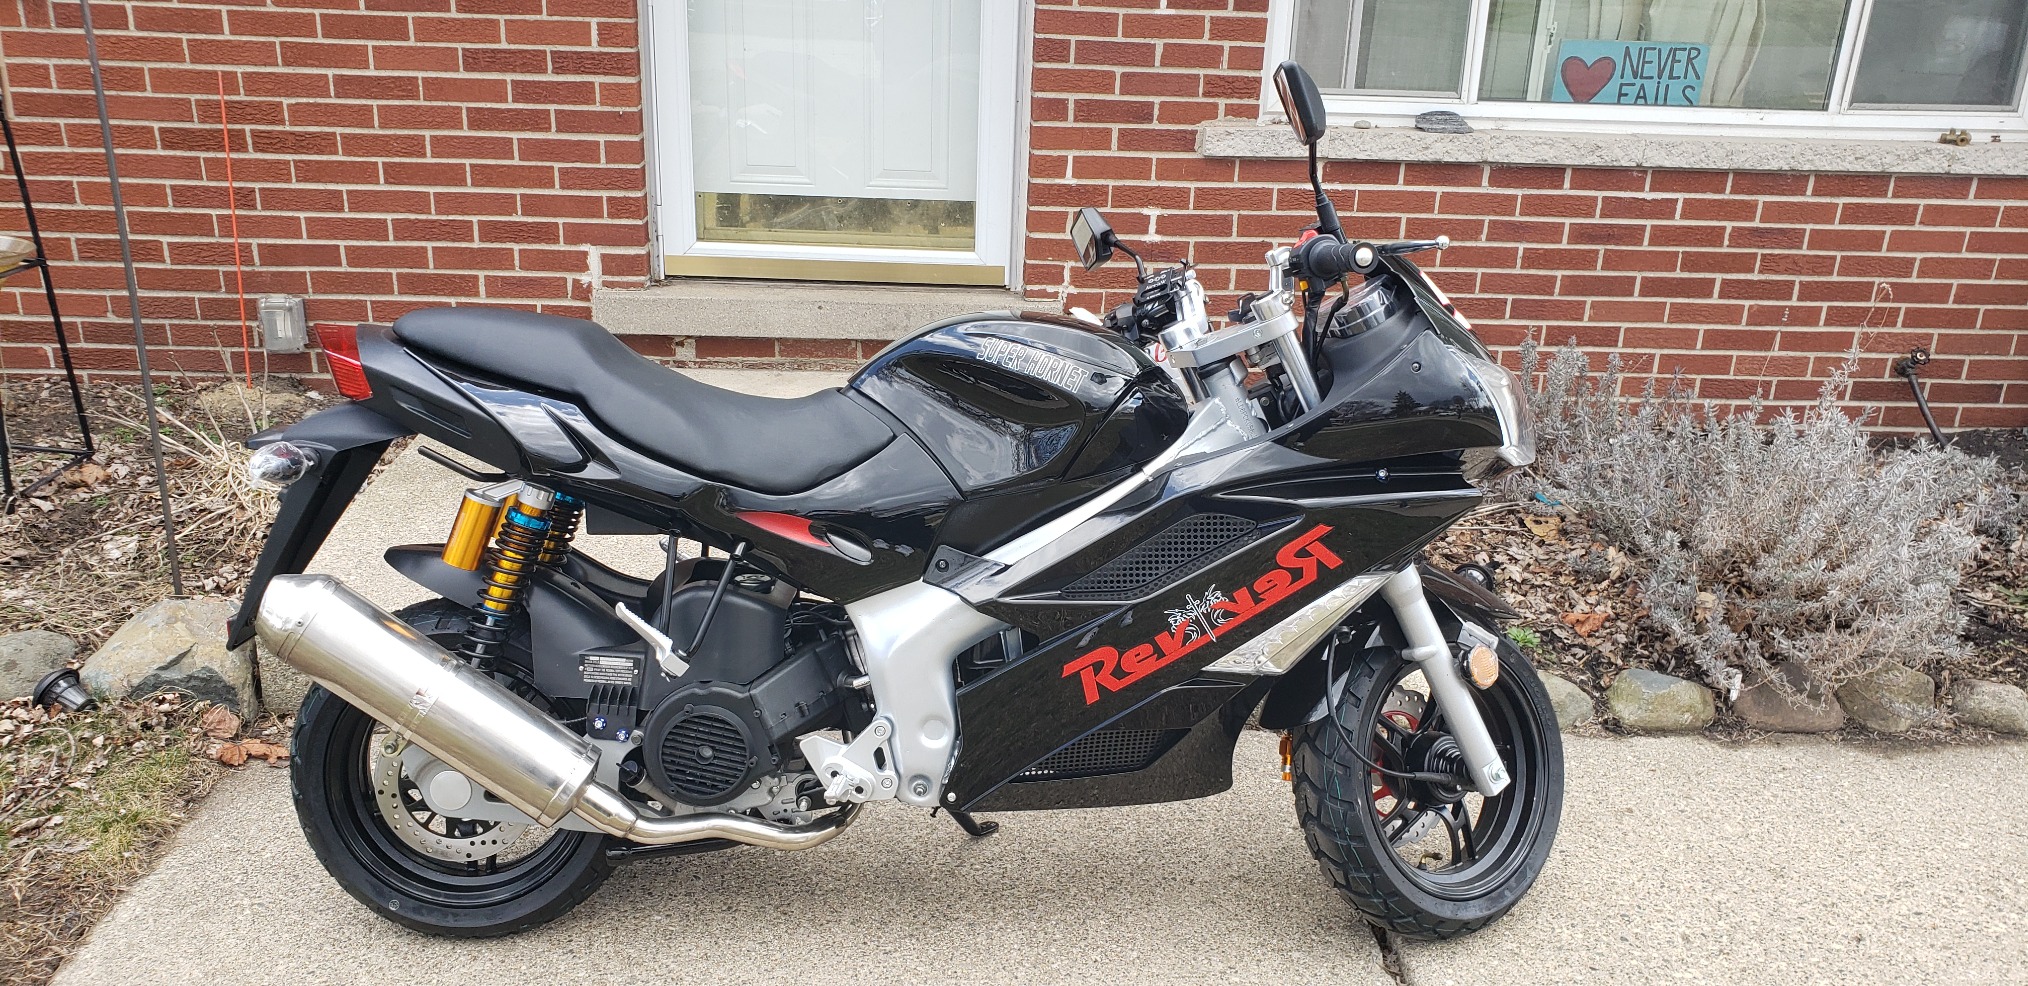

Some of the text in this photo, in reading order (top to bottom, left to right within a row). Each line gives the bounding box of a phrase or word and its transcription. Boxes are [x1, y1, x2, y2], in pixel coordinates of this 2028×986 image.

[1619, 45, 1701, 80] NEVER
[976, 336, 1090, 394] SUPER HORNET
